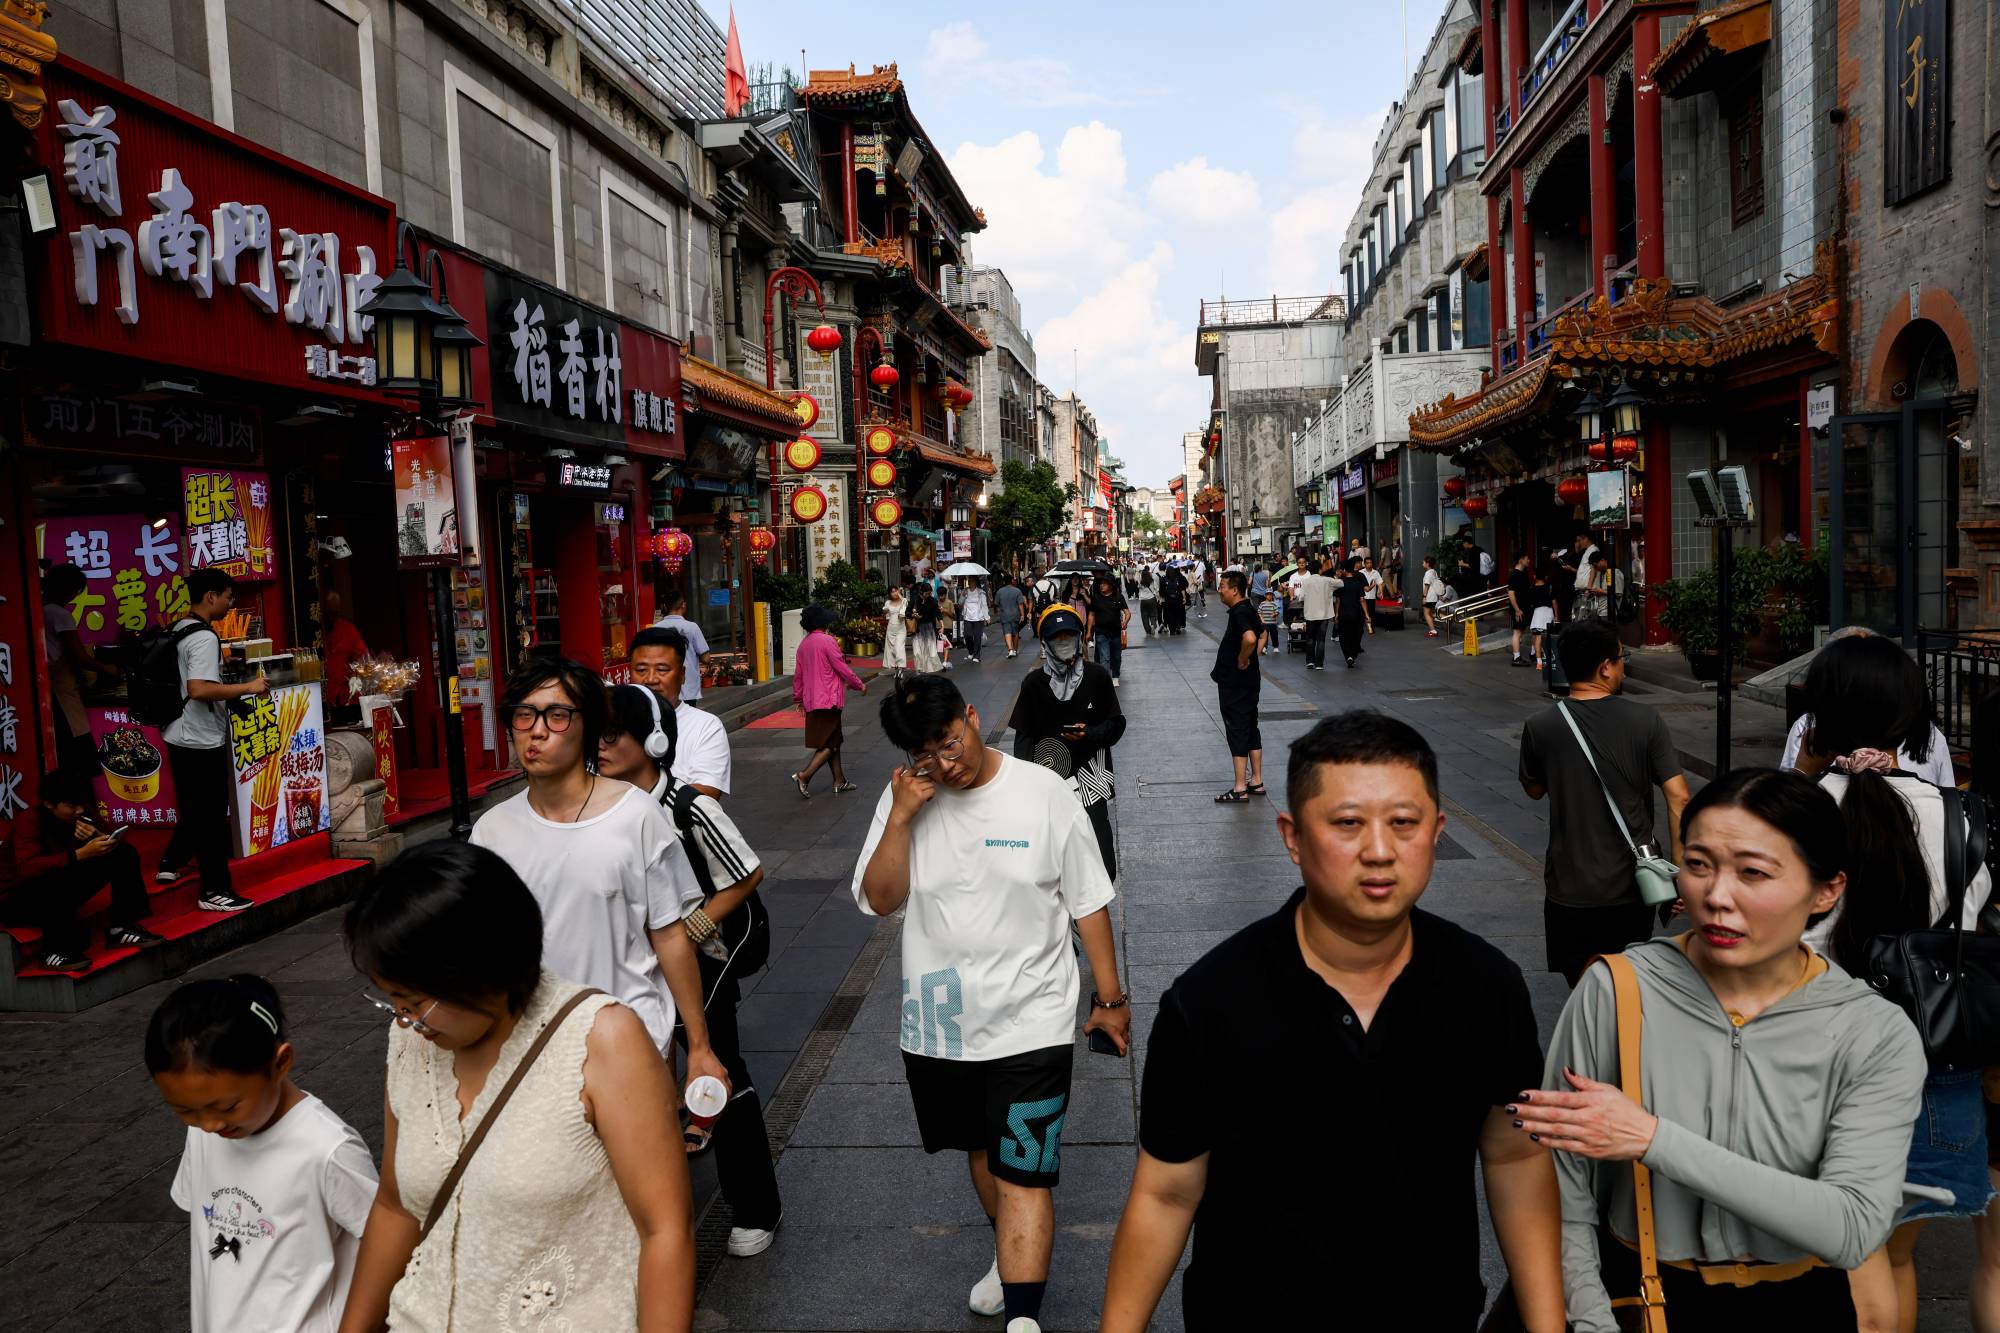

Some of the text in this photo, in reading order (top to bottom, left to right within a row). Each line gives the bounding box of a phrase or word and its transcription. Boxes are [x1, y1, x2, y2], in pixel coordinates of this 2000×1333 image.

[510, 297, 622, 425] 稻香村
[633, 388, 676, 435] 旗舰店
[186, 474, 236, 527] 超长
[65, 524, 179, 579] 超长
[235, 726, 281, 769] 大薯条
[280, 746, 324, 777] 酸梅汤
[291, 729, 316, 751] 冰镇
[123, 783, 148, 794] 臭豆腐
[112, 807, 178, 823] 招牌臭豆腐
